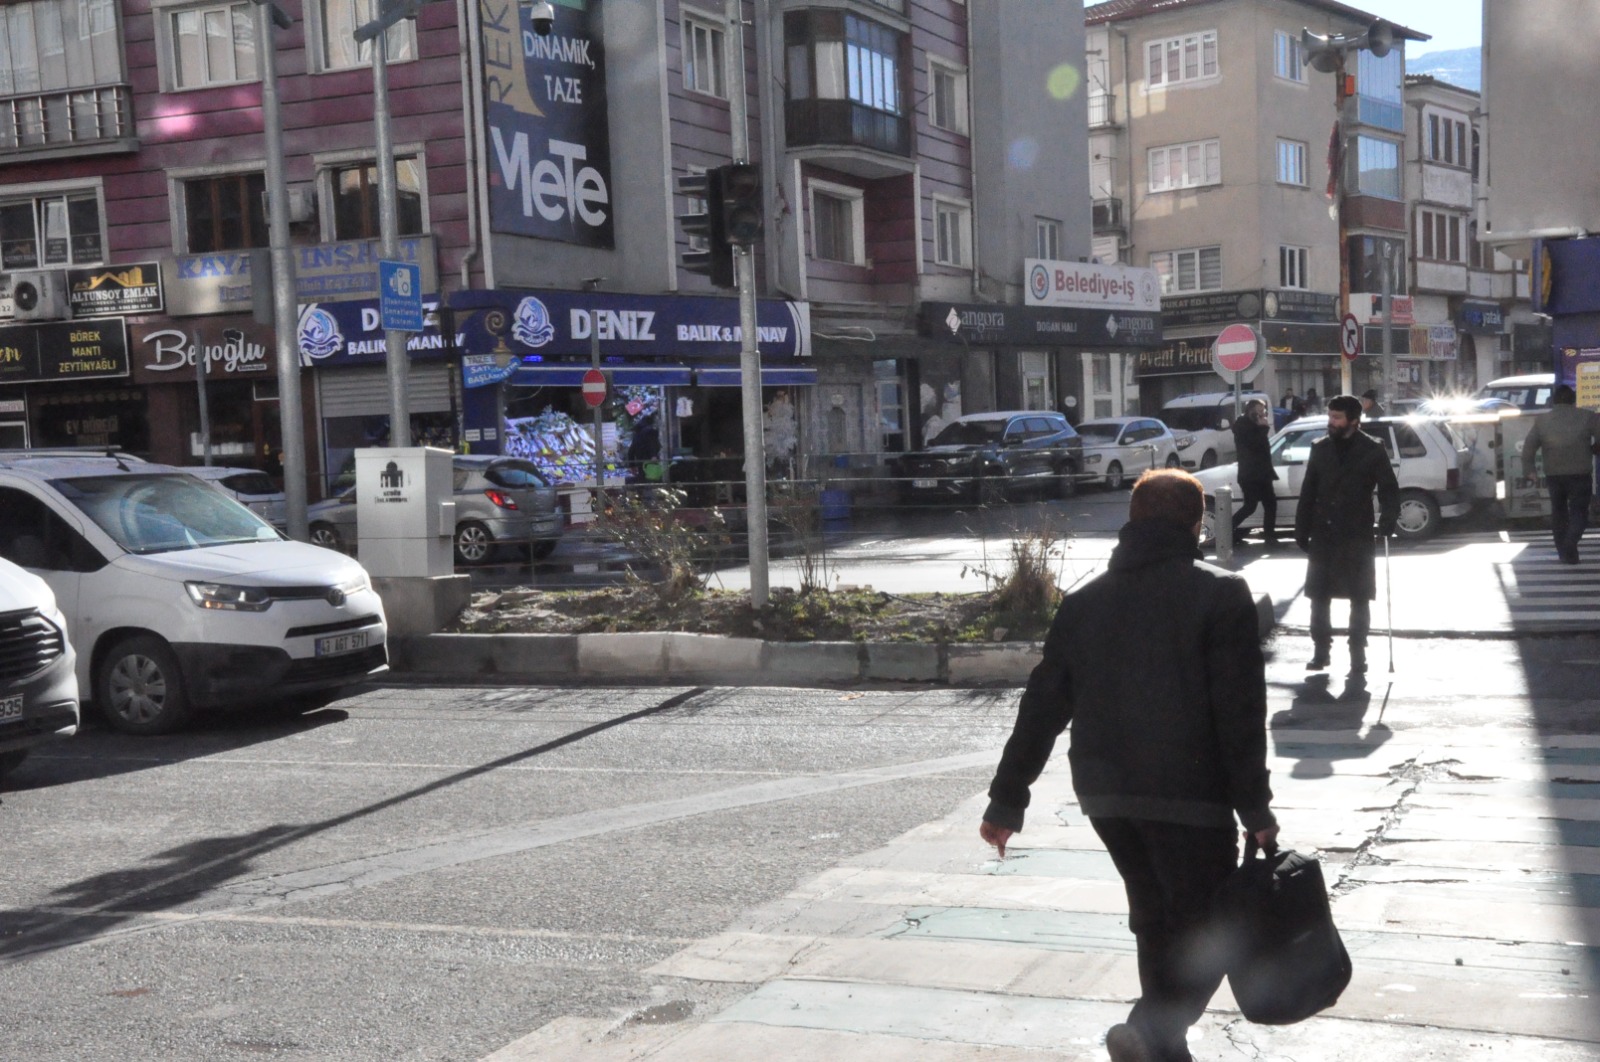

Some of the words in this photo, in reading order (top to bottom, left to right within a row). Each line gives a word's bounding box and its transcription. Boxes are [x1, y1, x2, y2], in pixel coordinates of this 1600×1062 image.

[544, 75, 582, 104] TAZE
[72, 289, 121, 303] ALTUNSOY
[123, 286, 157, 299] EMLAK
[1055, 269, 1135, 302] Belediye-iş
[961, 311, 1004, 333] angora
[1118, 316, 1154, 337] angora
[1482, 310, 1501, 327] yatak
[69, 330, 101, 343] BÖREK
[406, 333, 465, 351] MANV
[71, 346, 101, 357] MANTI
